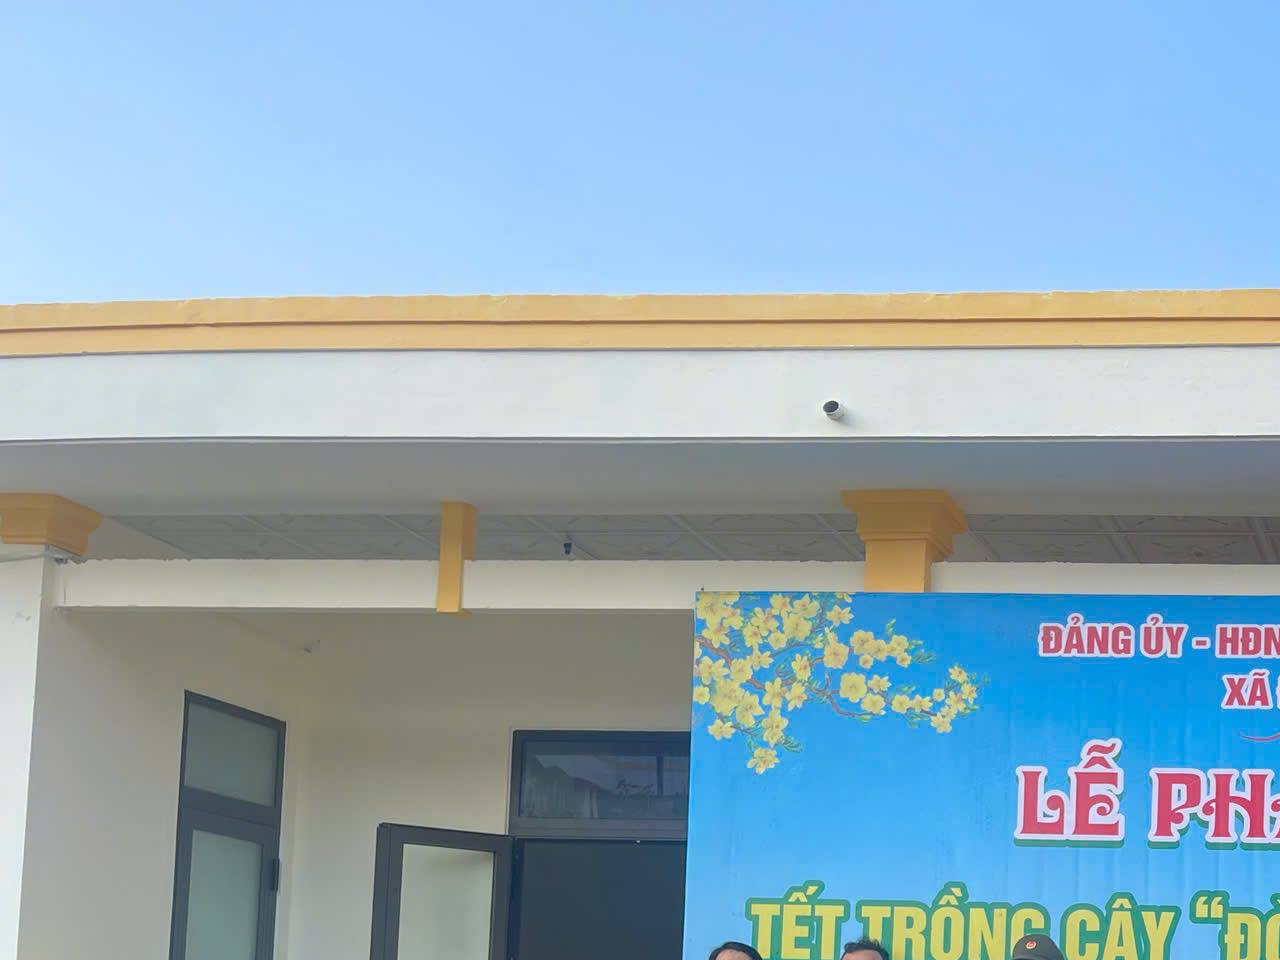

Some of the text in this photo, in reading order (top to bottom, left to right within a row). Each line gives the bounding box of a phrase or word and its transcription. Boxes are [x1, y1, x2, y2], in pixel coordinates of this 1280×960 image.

[1039, 613, 1133, 656] ĐẢNG
[1141, 614, 1186, 657] ỦY
[1224, 666, 1270, 707] XÃ
[1018, 741, 1121, 838] LỄ
[749, 885, 845, 960] TẾT
